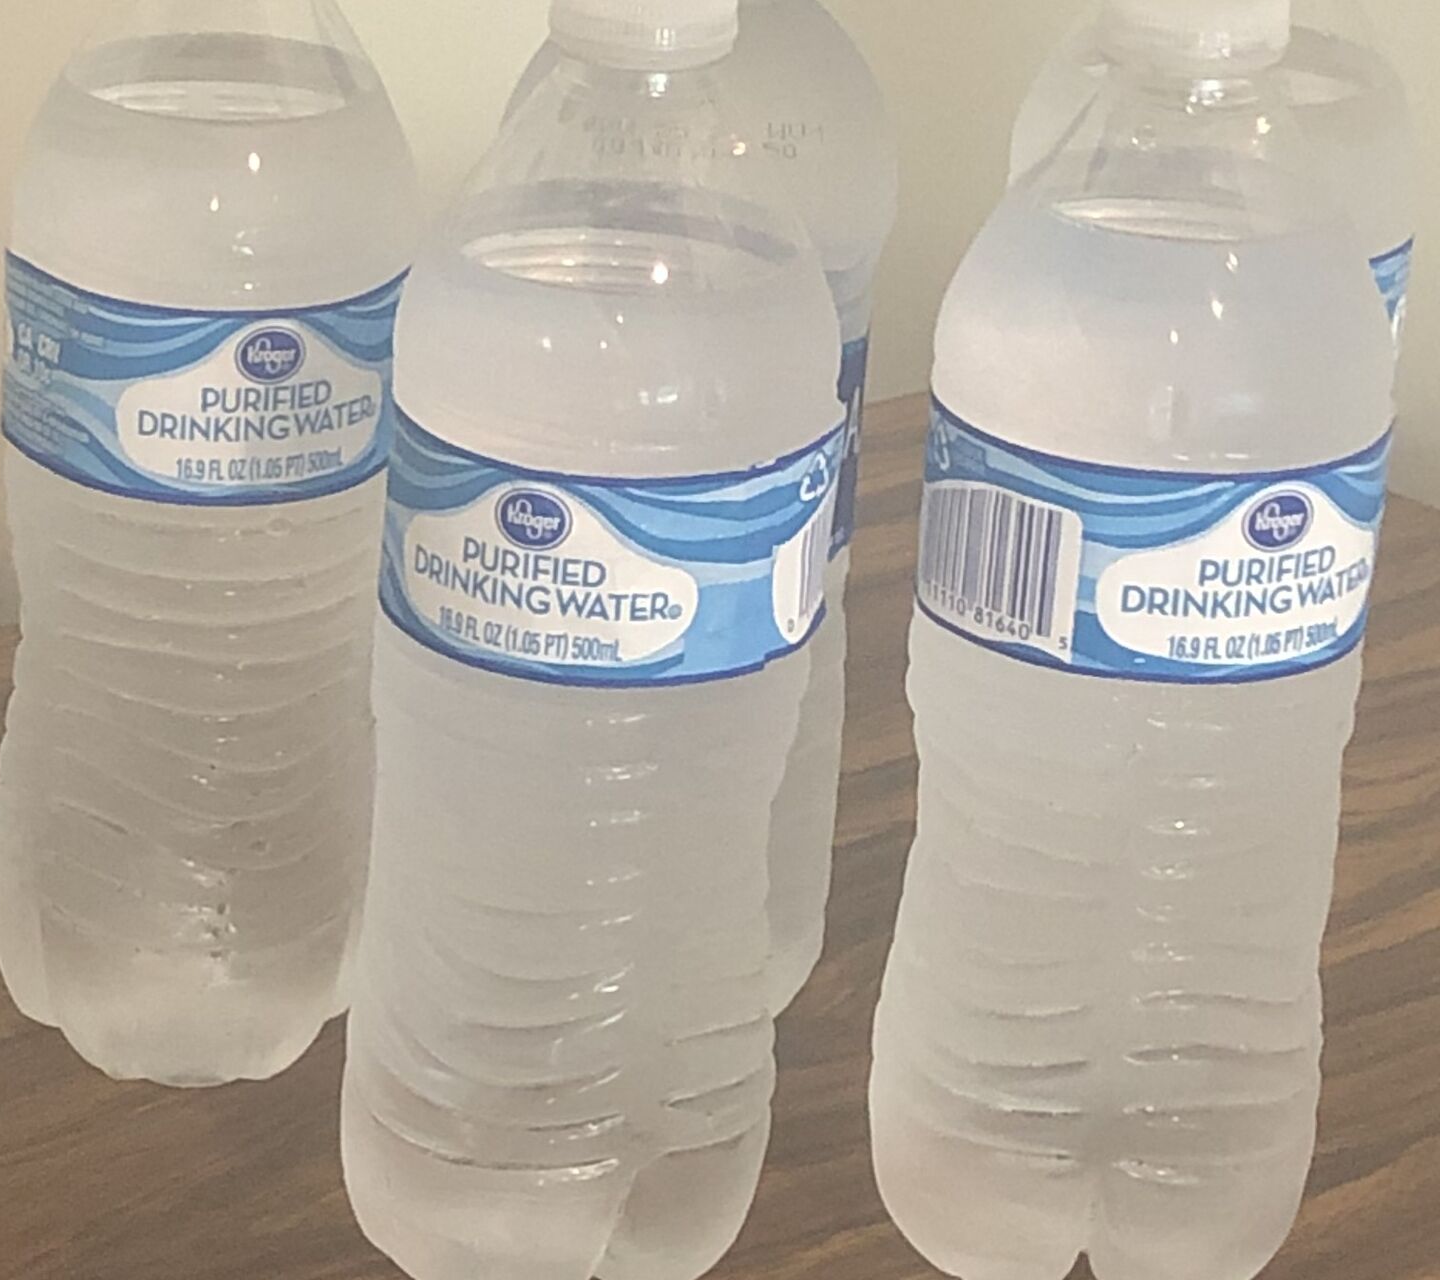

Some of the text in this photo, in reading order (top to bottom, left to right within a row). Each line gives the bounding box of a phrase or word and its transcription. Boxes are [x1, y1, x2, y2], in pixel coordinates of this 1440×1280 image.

[247, 336, 296, 375] Kroger
[201, 380, 332, 414] PURIFIED
[137, 409, 289, 441] DRINKING
[176, 457, 205, 481] 16.9
[208, 459, 225, 481] FL
[228, 458, 246, 480] OZ
[506, 499, 561, 539] Kroger
[1255, 502, 1305, 542] Kroger
[414, 546, 551, 615] DRINKING
[462, 536, 607, 588] PURIFIED
[1198, 545, 1336, 587] PURIFIED
[1121, 584, 1293, 619] DRINKING
[465, 616, 480, 641] FL
[483, 621, 503, 647] OZ
[505, 625, 541, 656] (1.05
[544, 632, 569, 661] PT)
[571, 636, 622, 662] 500mL
[973, 606, 1031, 641] 81640
[1058, 636, 1068, 650] 5
[1167, 635, 1200, 659] 16.9
[1203, 636, 1221, 660] FL
[1226, 635, 1246, 659] OZ
